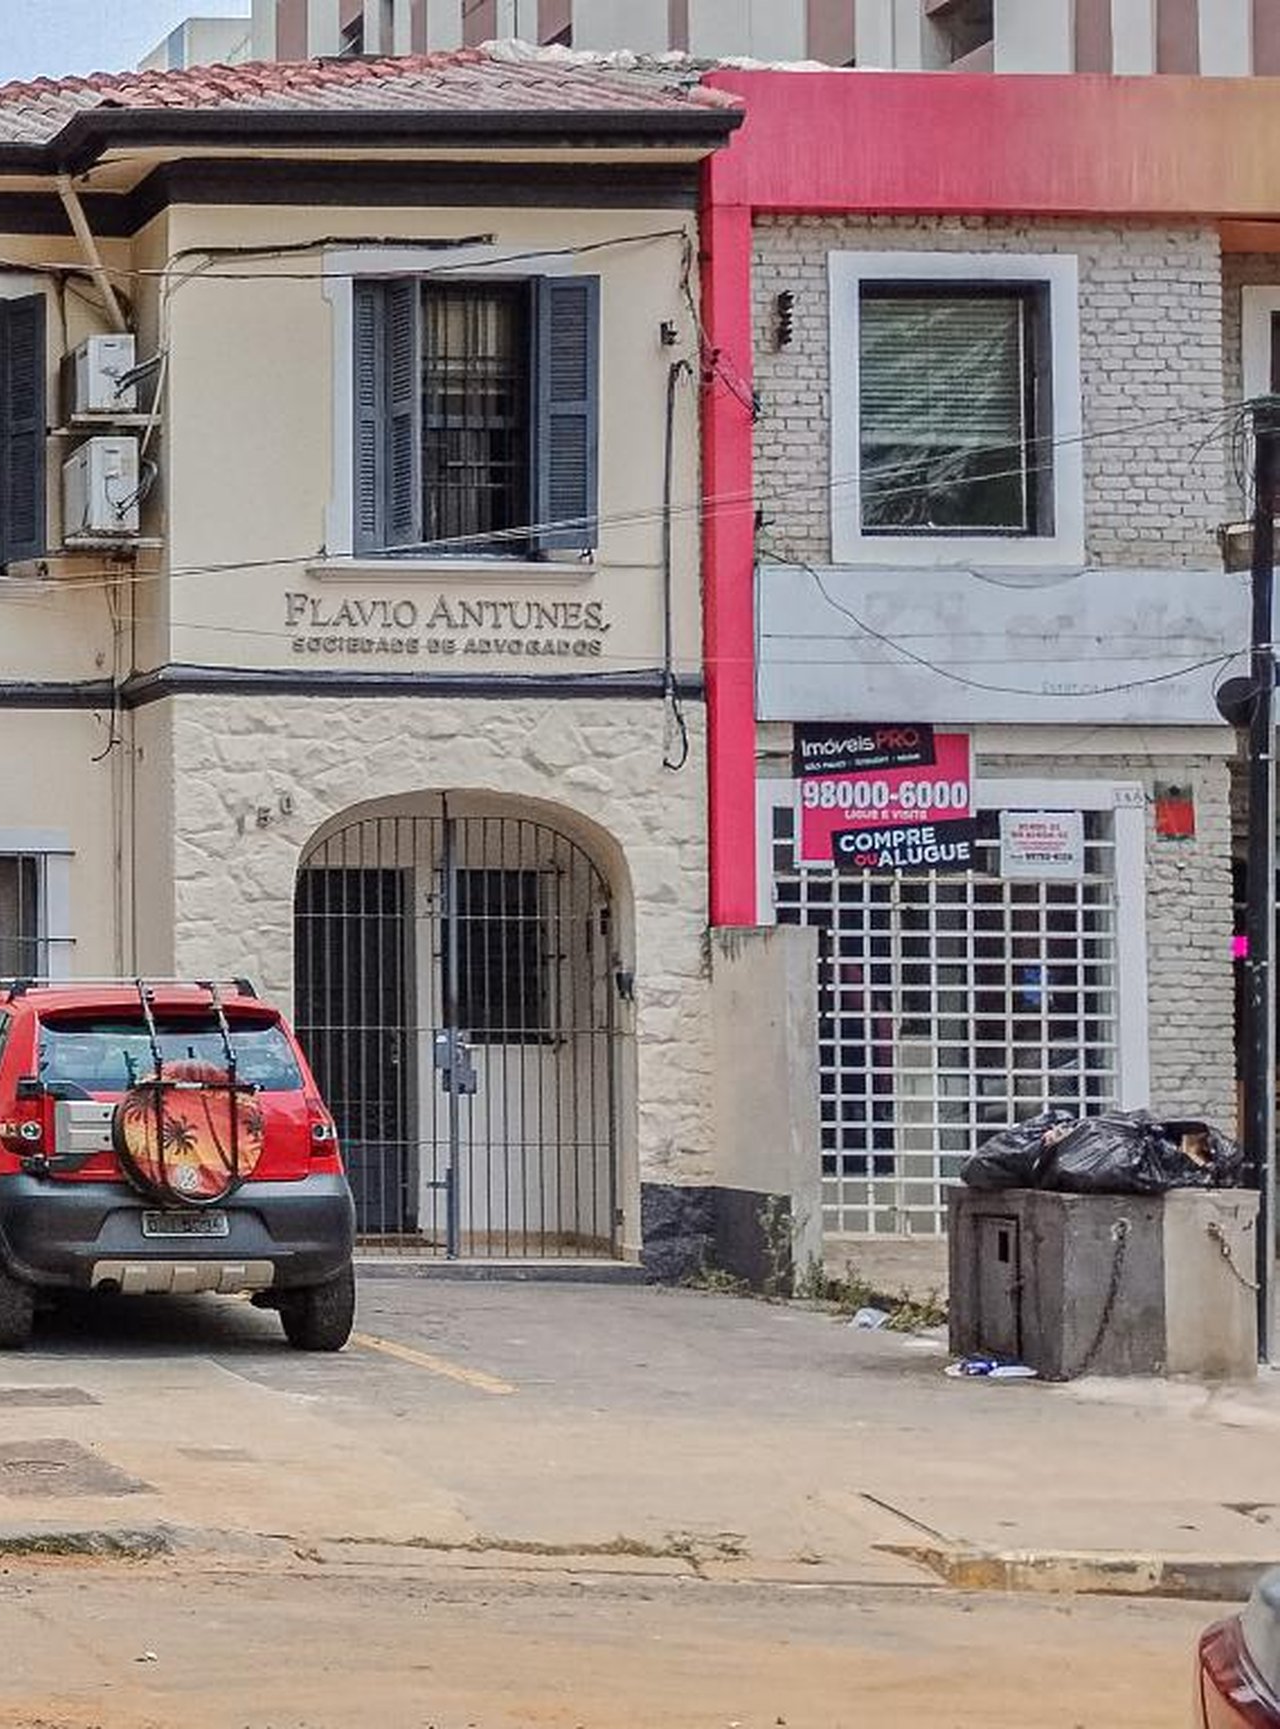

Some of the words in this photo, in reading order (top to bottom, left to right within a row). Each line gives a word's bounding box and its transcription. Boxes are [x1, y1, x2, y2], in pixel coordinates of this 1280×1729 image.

[284, 591, 418, 629] FLAVIO
[291, 635, 420, 655] SOCIEDADE
[426, 637, 457, 655] DE
[462, 637, 604, 657] ADVOGADOS
[802, 780, 970, 809] 98000-6000
[839, 826, 937, 853] COMPRE
[877, 841, 971, 868] ALUGUE
